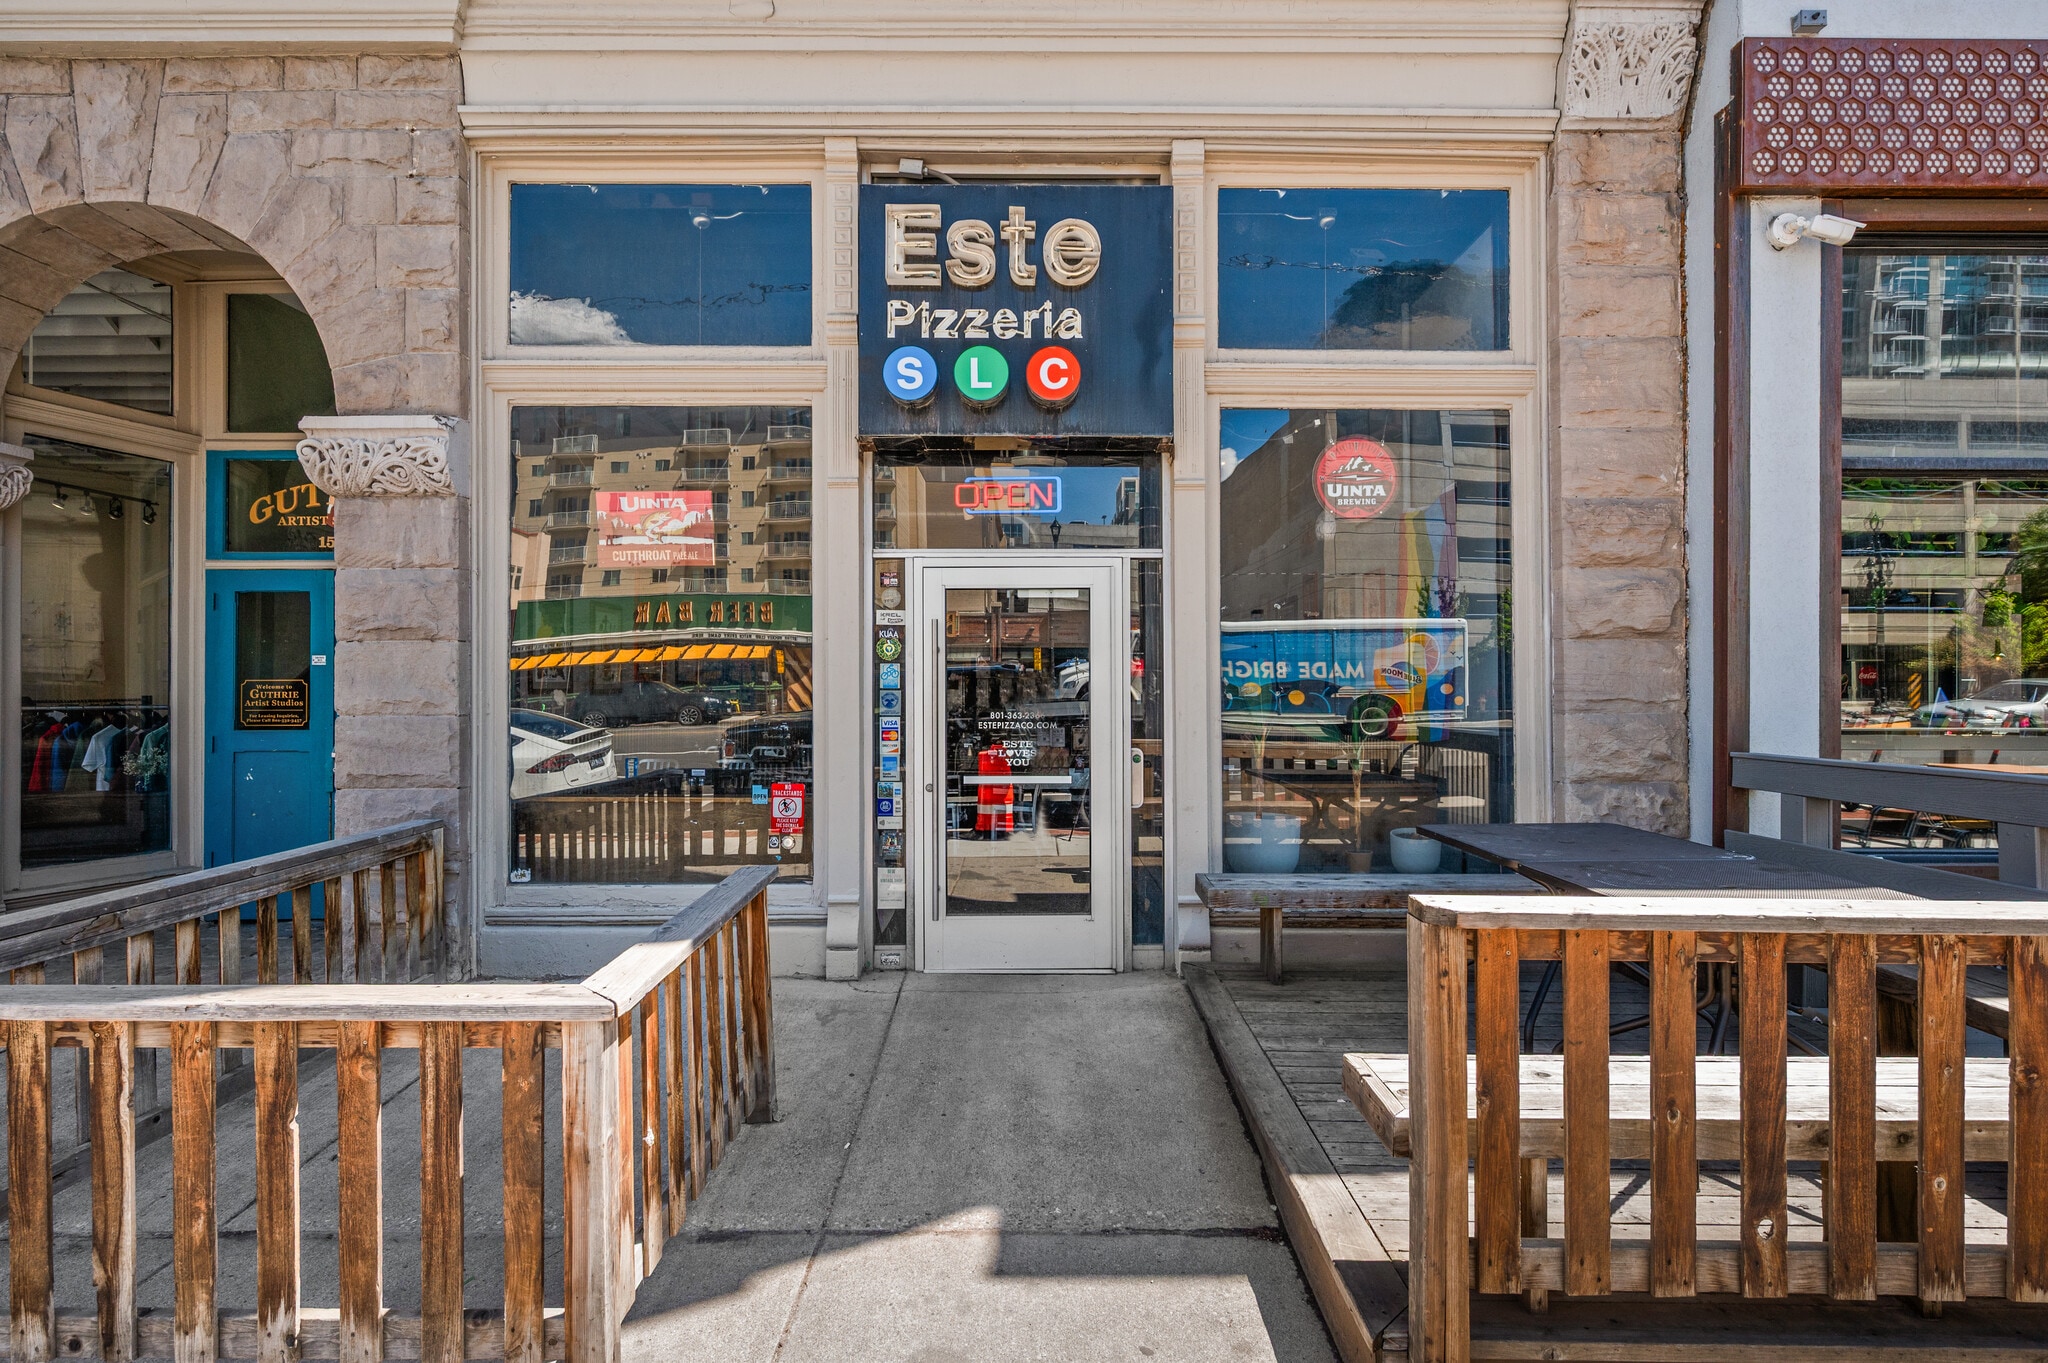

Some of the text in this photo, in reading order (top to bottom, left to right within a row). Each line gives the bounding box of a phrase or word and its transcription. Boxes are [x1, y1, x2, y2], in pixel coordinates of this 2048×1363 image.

[885, 203, 1101, 287] Este
[887, 300, 1083, 340] Pizzeria
[896, 356, 1069, 390] S L C
[954, 482, 1053, 508] OPEN
[1327, 484, 1386, 497] UINTA
[249, 483, 329, 525] GUT
[619, 496, 688, 513] UINTA
[1337, 498, 1377, 506] BREWING
[277, 515, 328, 526] ARTIST
[612, 549, 698, 561] CUTTHROAT PALE ALE
[879, 630, 898, 638] KUAA
[249, 689, 299, 699] GUTHRIE
[244, 699, 304, 707] Artist Studios
[978, 721, 1058, 729] ESTEPIZZACO.COM
[1002, 740, 1033, 748] ESTE
[1005, 758, 1031, 766] YOU
